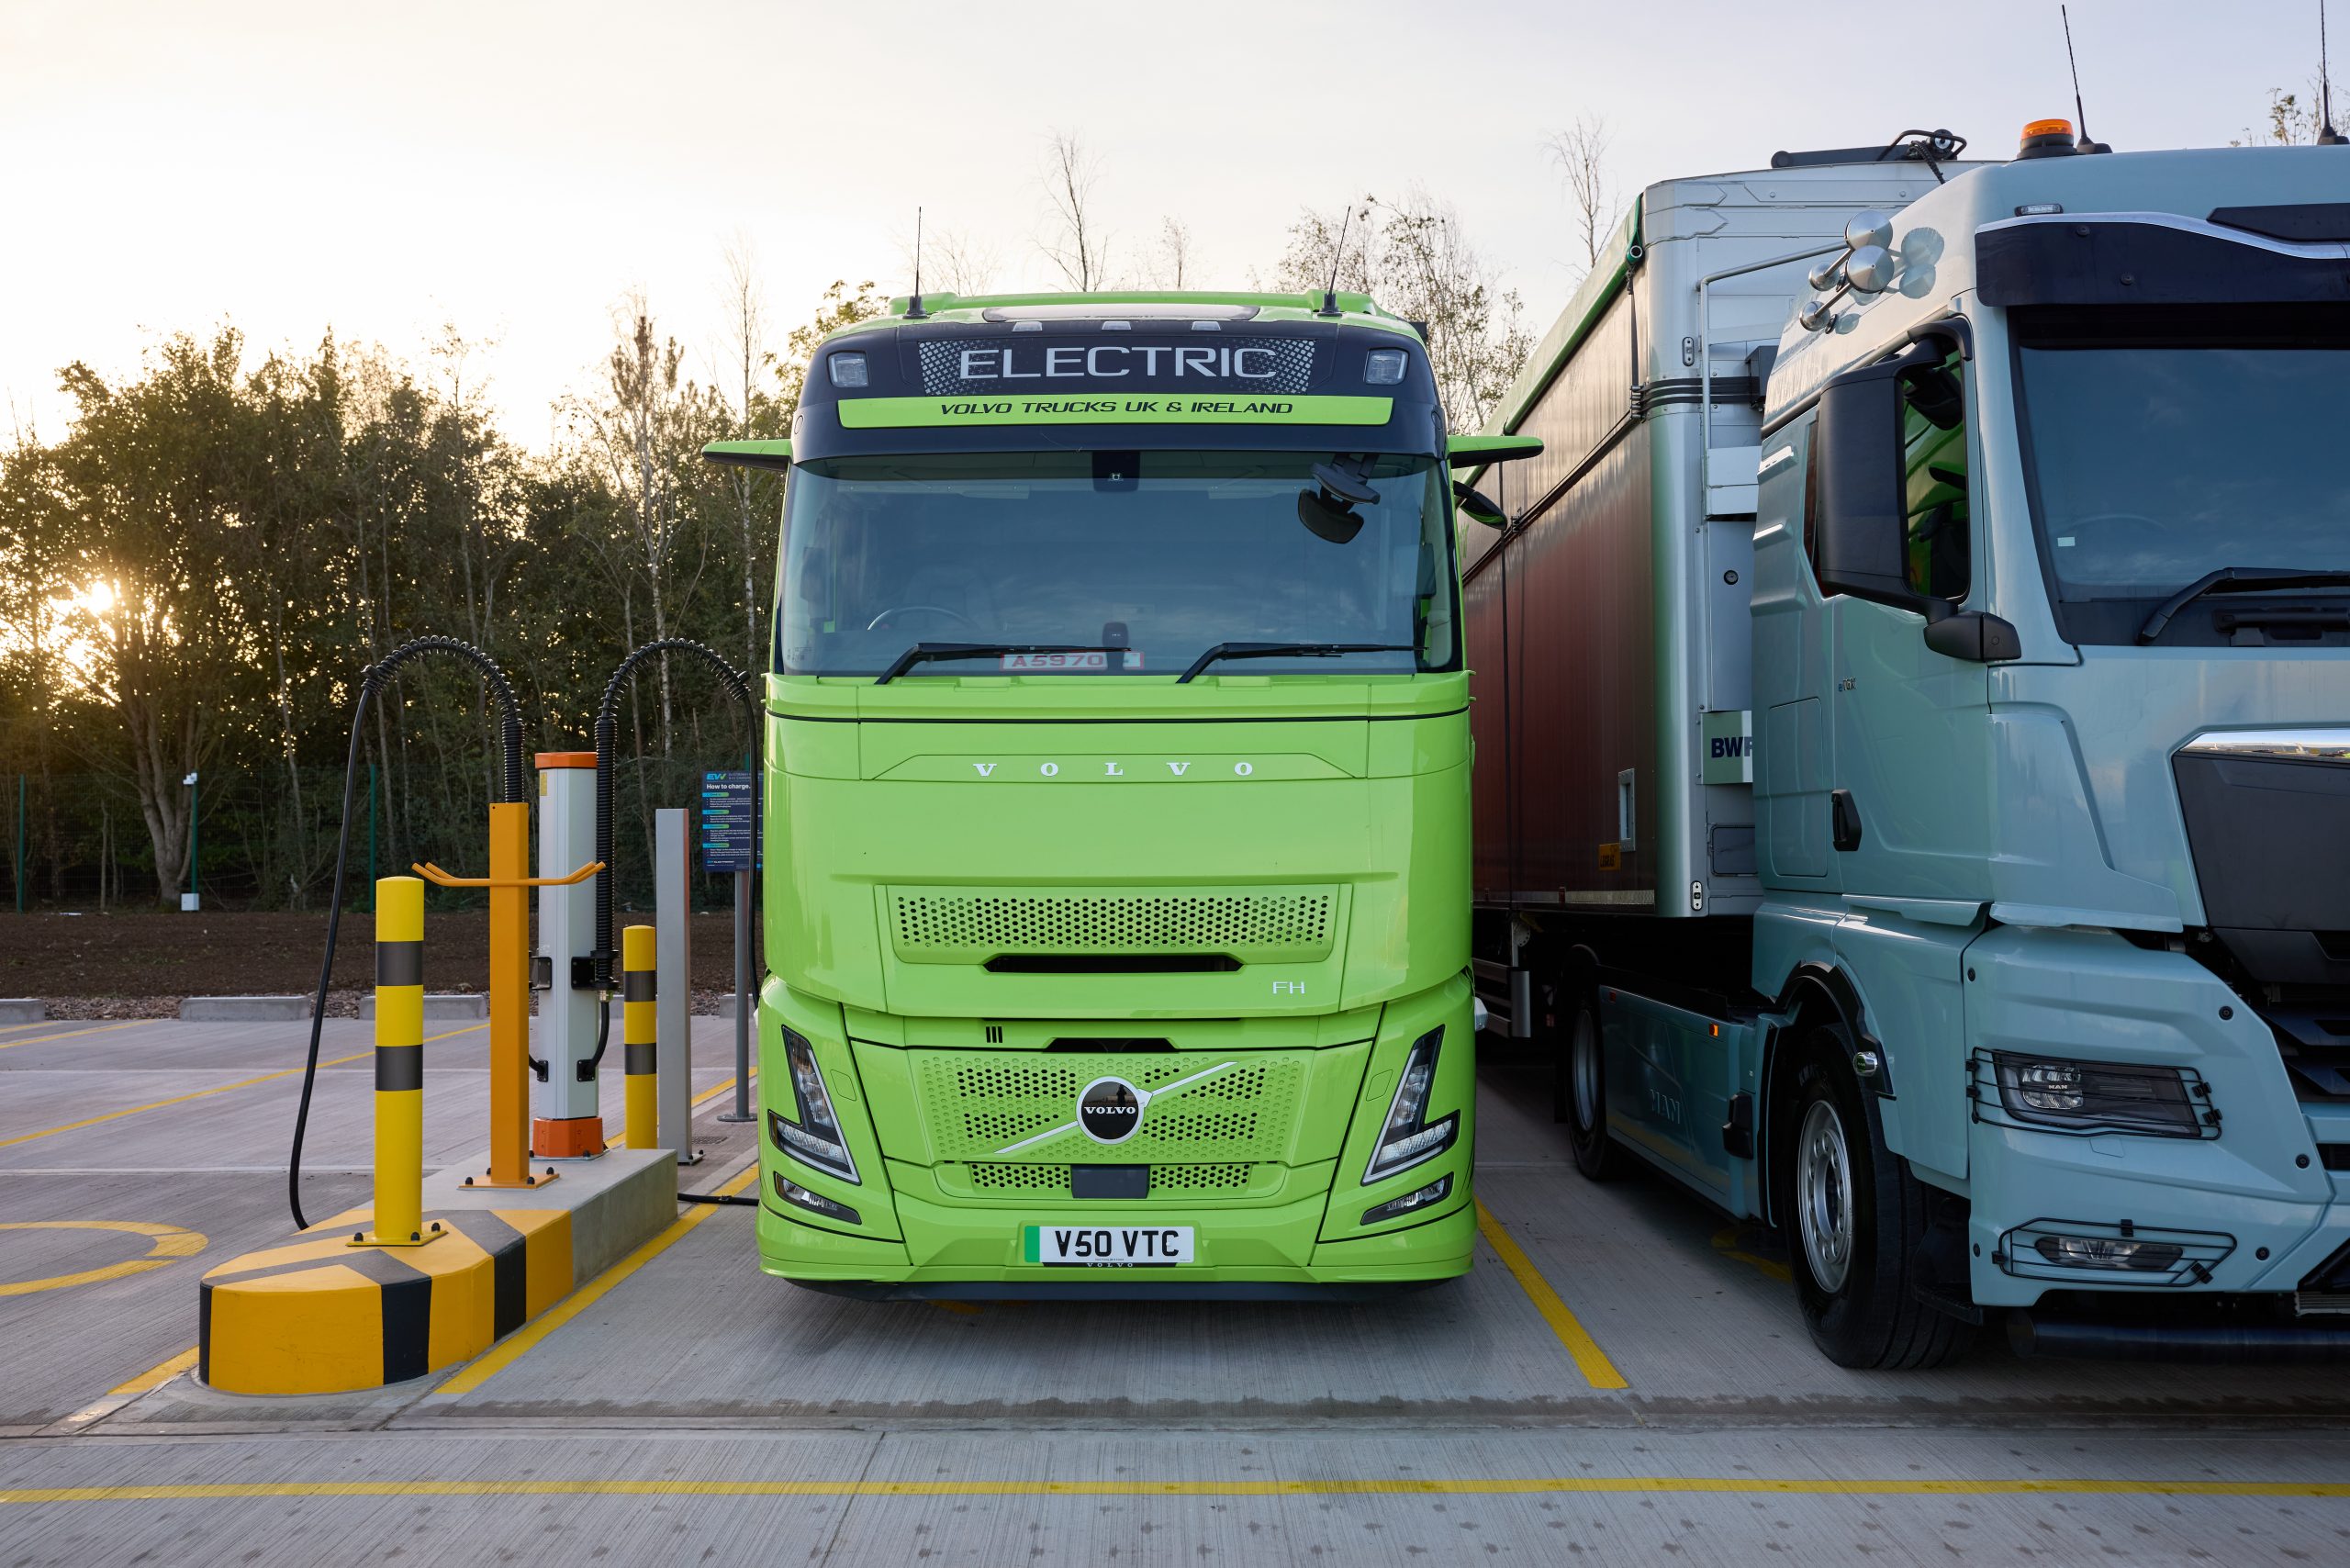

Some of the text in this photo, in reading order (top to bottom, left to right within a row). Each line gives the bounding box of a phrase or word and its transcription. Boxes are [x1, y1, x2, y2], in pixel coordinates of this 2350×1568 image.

[959, 346, 1277, 379] ELECTRIC
[941, 401, 1292, 414] VOLVO TRUCKS UK & IRELAND
[1012, 655, 1104, 667] A5970
[973, 762, 1253, 777] VOLVO
[1272, 981, 1305, 994] FH
[1084, 1106, 1136, 1114] VOLVO
[1055, 1230, 1180, 1258] V50 VTC
